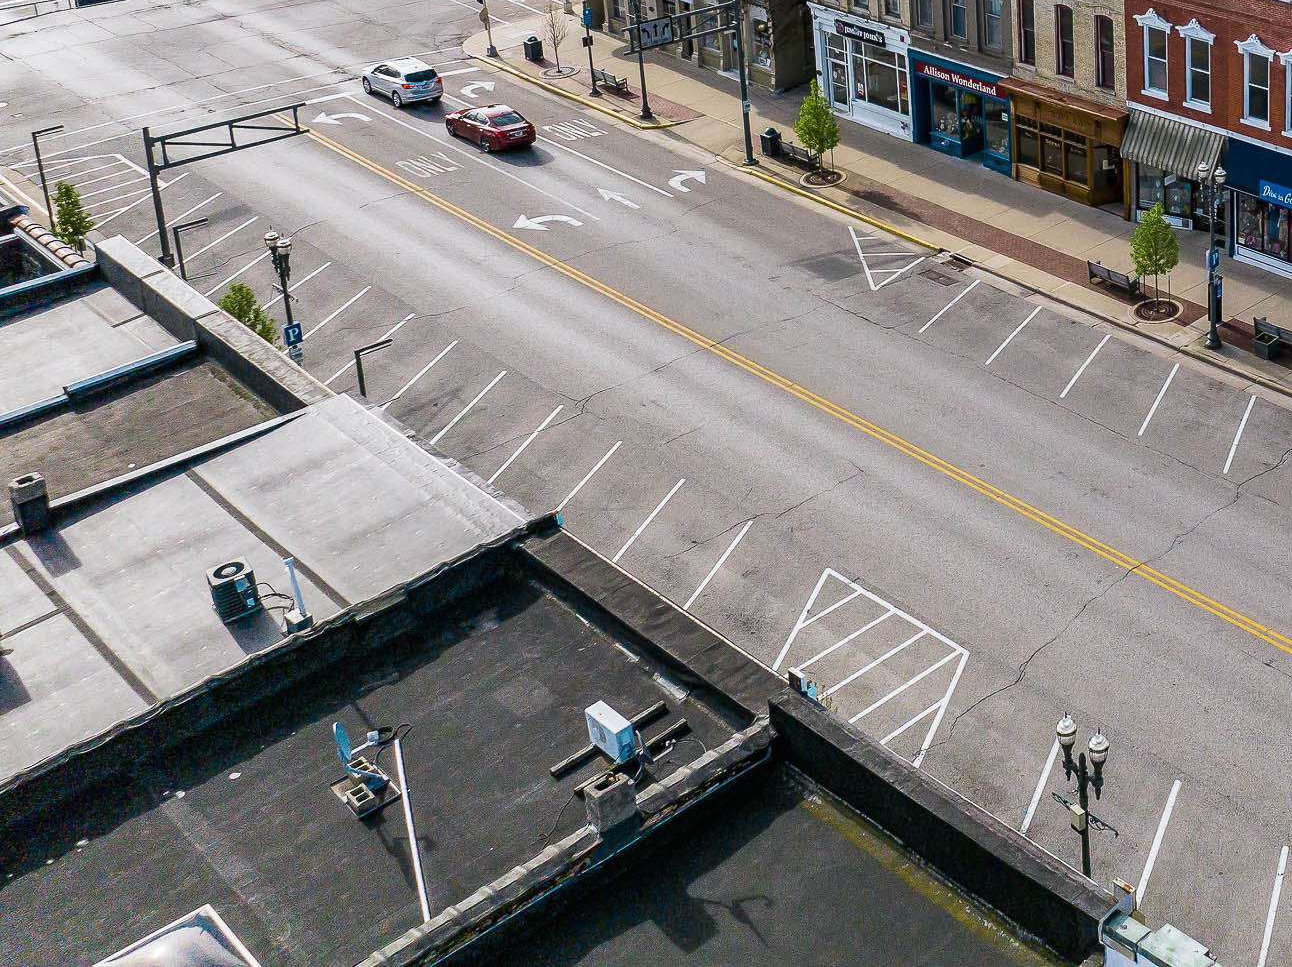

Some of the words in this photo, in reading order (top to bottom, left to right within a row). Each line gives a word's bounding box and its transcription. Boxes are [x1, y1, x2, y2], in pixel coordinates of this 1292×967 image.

[923, 64, 951, 82] Allison
[951, 73, 997, 97] Wonderland
[542, 118, 609, 142] ONLY
[395, 151, 465, 179] ONLY
[288, 327, 299, 342] P
